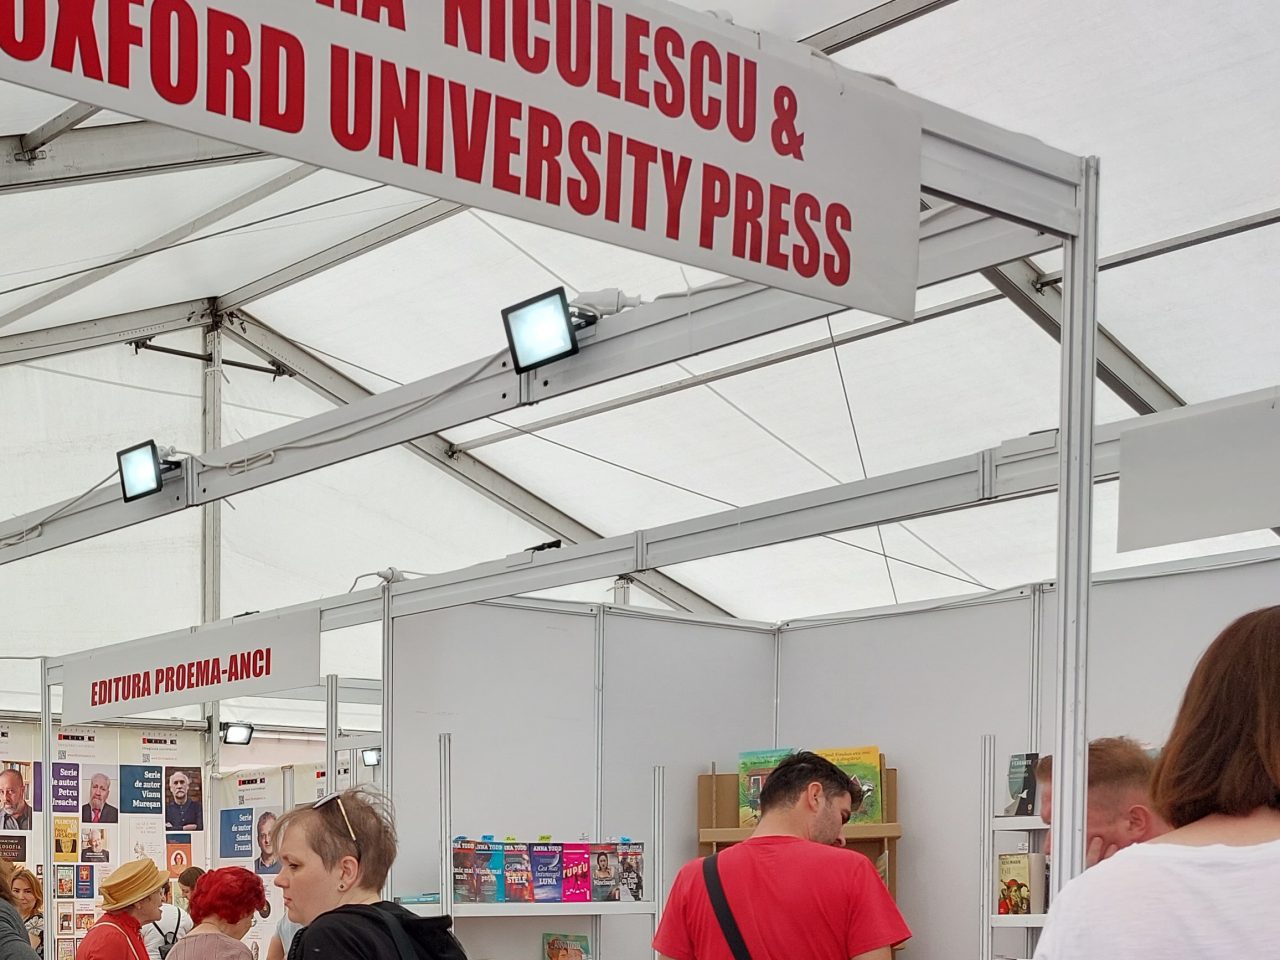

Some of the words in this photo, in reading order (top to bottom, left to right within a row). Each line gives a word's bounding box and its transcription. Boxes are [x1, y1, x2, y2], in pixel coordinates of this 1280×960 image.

[770, 86, 805, 161] &
[329, 44, 692, 243] UNIVERSITY
[699, 176, 853, 288] PRESS
[90, 671, 151, 707] EDITURA
[155, 648, 272, 695] PROEMA-ANCI
[60, 768, 78, 777] Serie
[144, 771, 160, 779] Serie
[58, 779, 77, 787] autor
[143, 781, 160, 789] autor
[58, 788, 78, 797] Petru
[142, 790, 160, 799] Vianu
[239, 813, 252, 822] Serie
[238, 824, 252, 832] autor
[539, 877, 557, 885] LUNA
